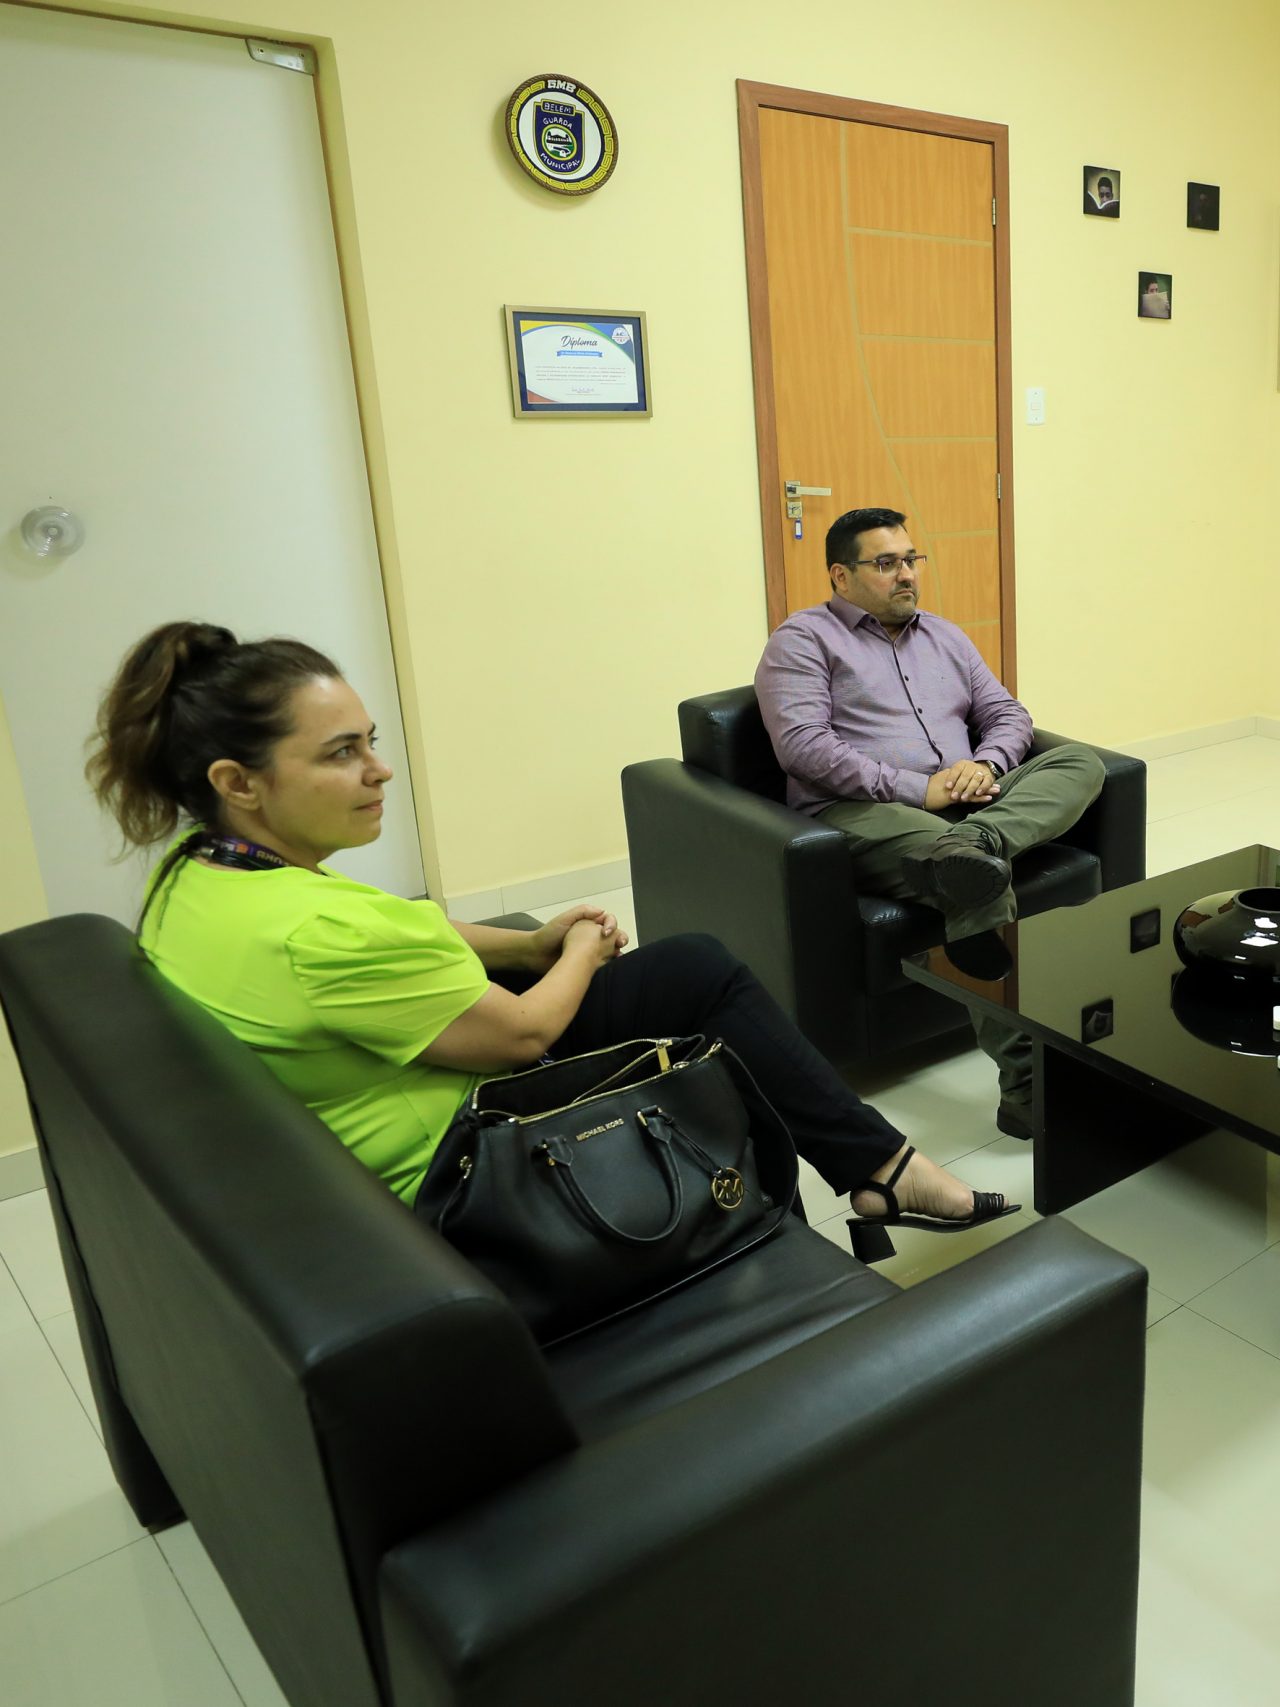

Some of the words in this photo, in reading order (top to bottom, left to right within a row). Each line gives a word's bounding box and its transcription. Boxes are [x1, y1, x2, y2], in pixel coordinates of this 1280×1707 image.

[547, 79, 576, 93] GMB
[542, 116, 573, 130] GUARDA
[540, 152, 580, 170] MUNICIPAL
[560, 335, 599, 349] Diploma
[576, 1125, 607, 1141] MICHAEL
[604, 1118, 624, 1130] KORS
